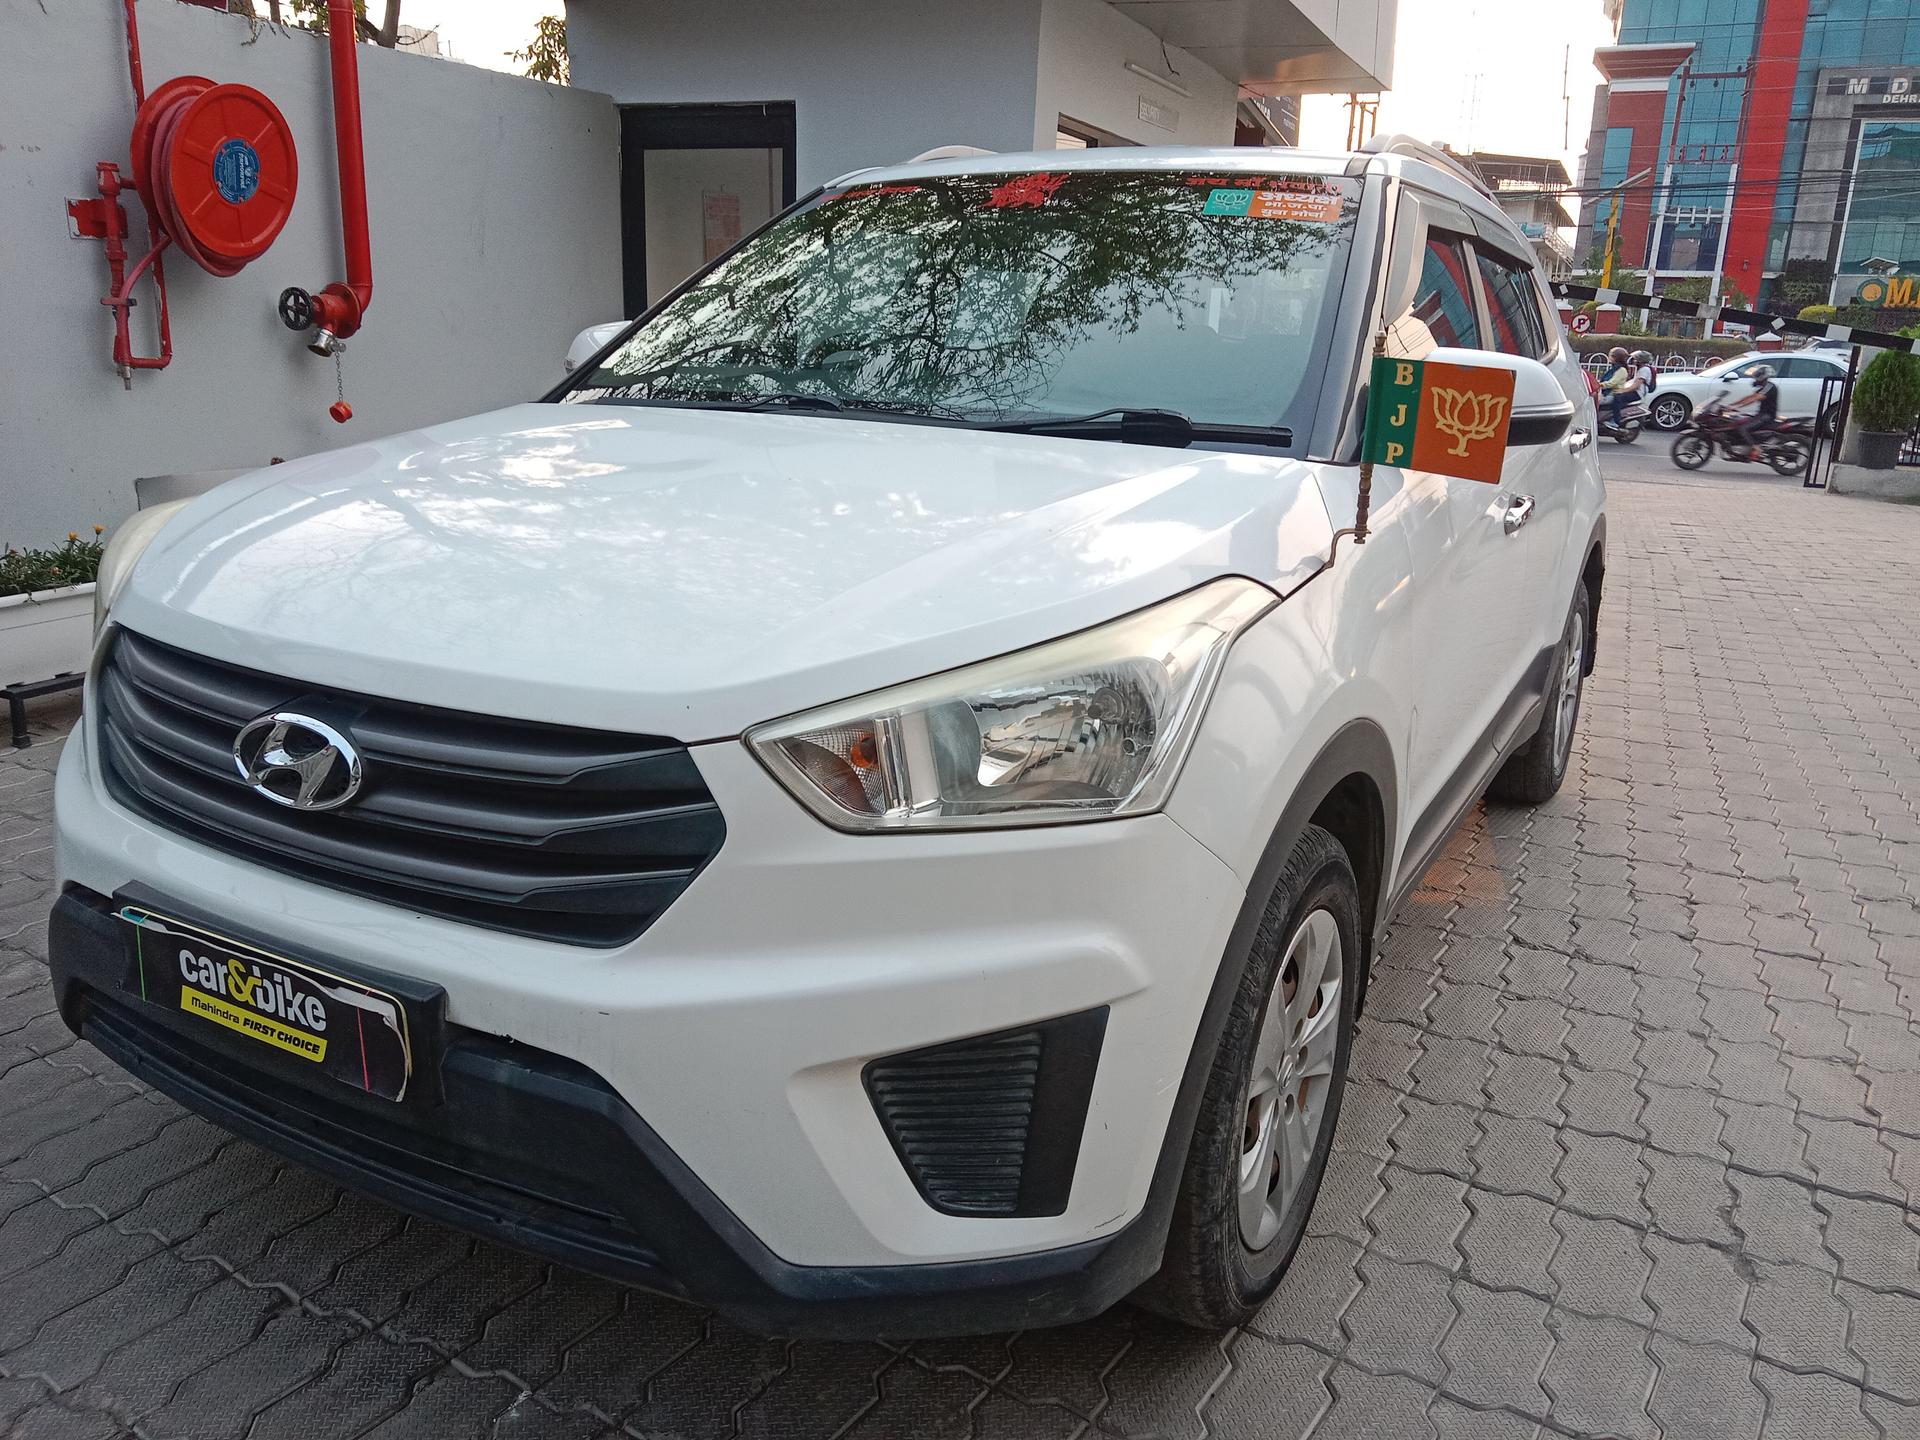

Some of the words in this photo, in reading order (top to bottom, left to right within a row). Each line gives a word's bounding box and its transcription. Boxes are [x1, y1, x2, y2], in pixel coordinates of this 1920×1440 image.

[1882, 94, 1920, 104] DEHR
[178, 949, 328, 1033] car&bike
[191, 996, 240, 1025] Mahindra
[242, 1017, 277, 1038] FIRST
[276, 1030, 320, 1055] CHOICE
